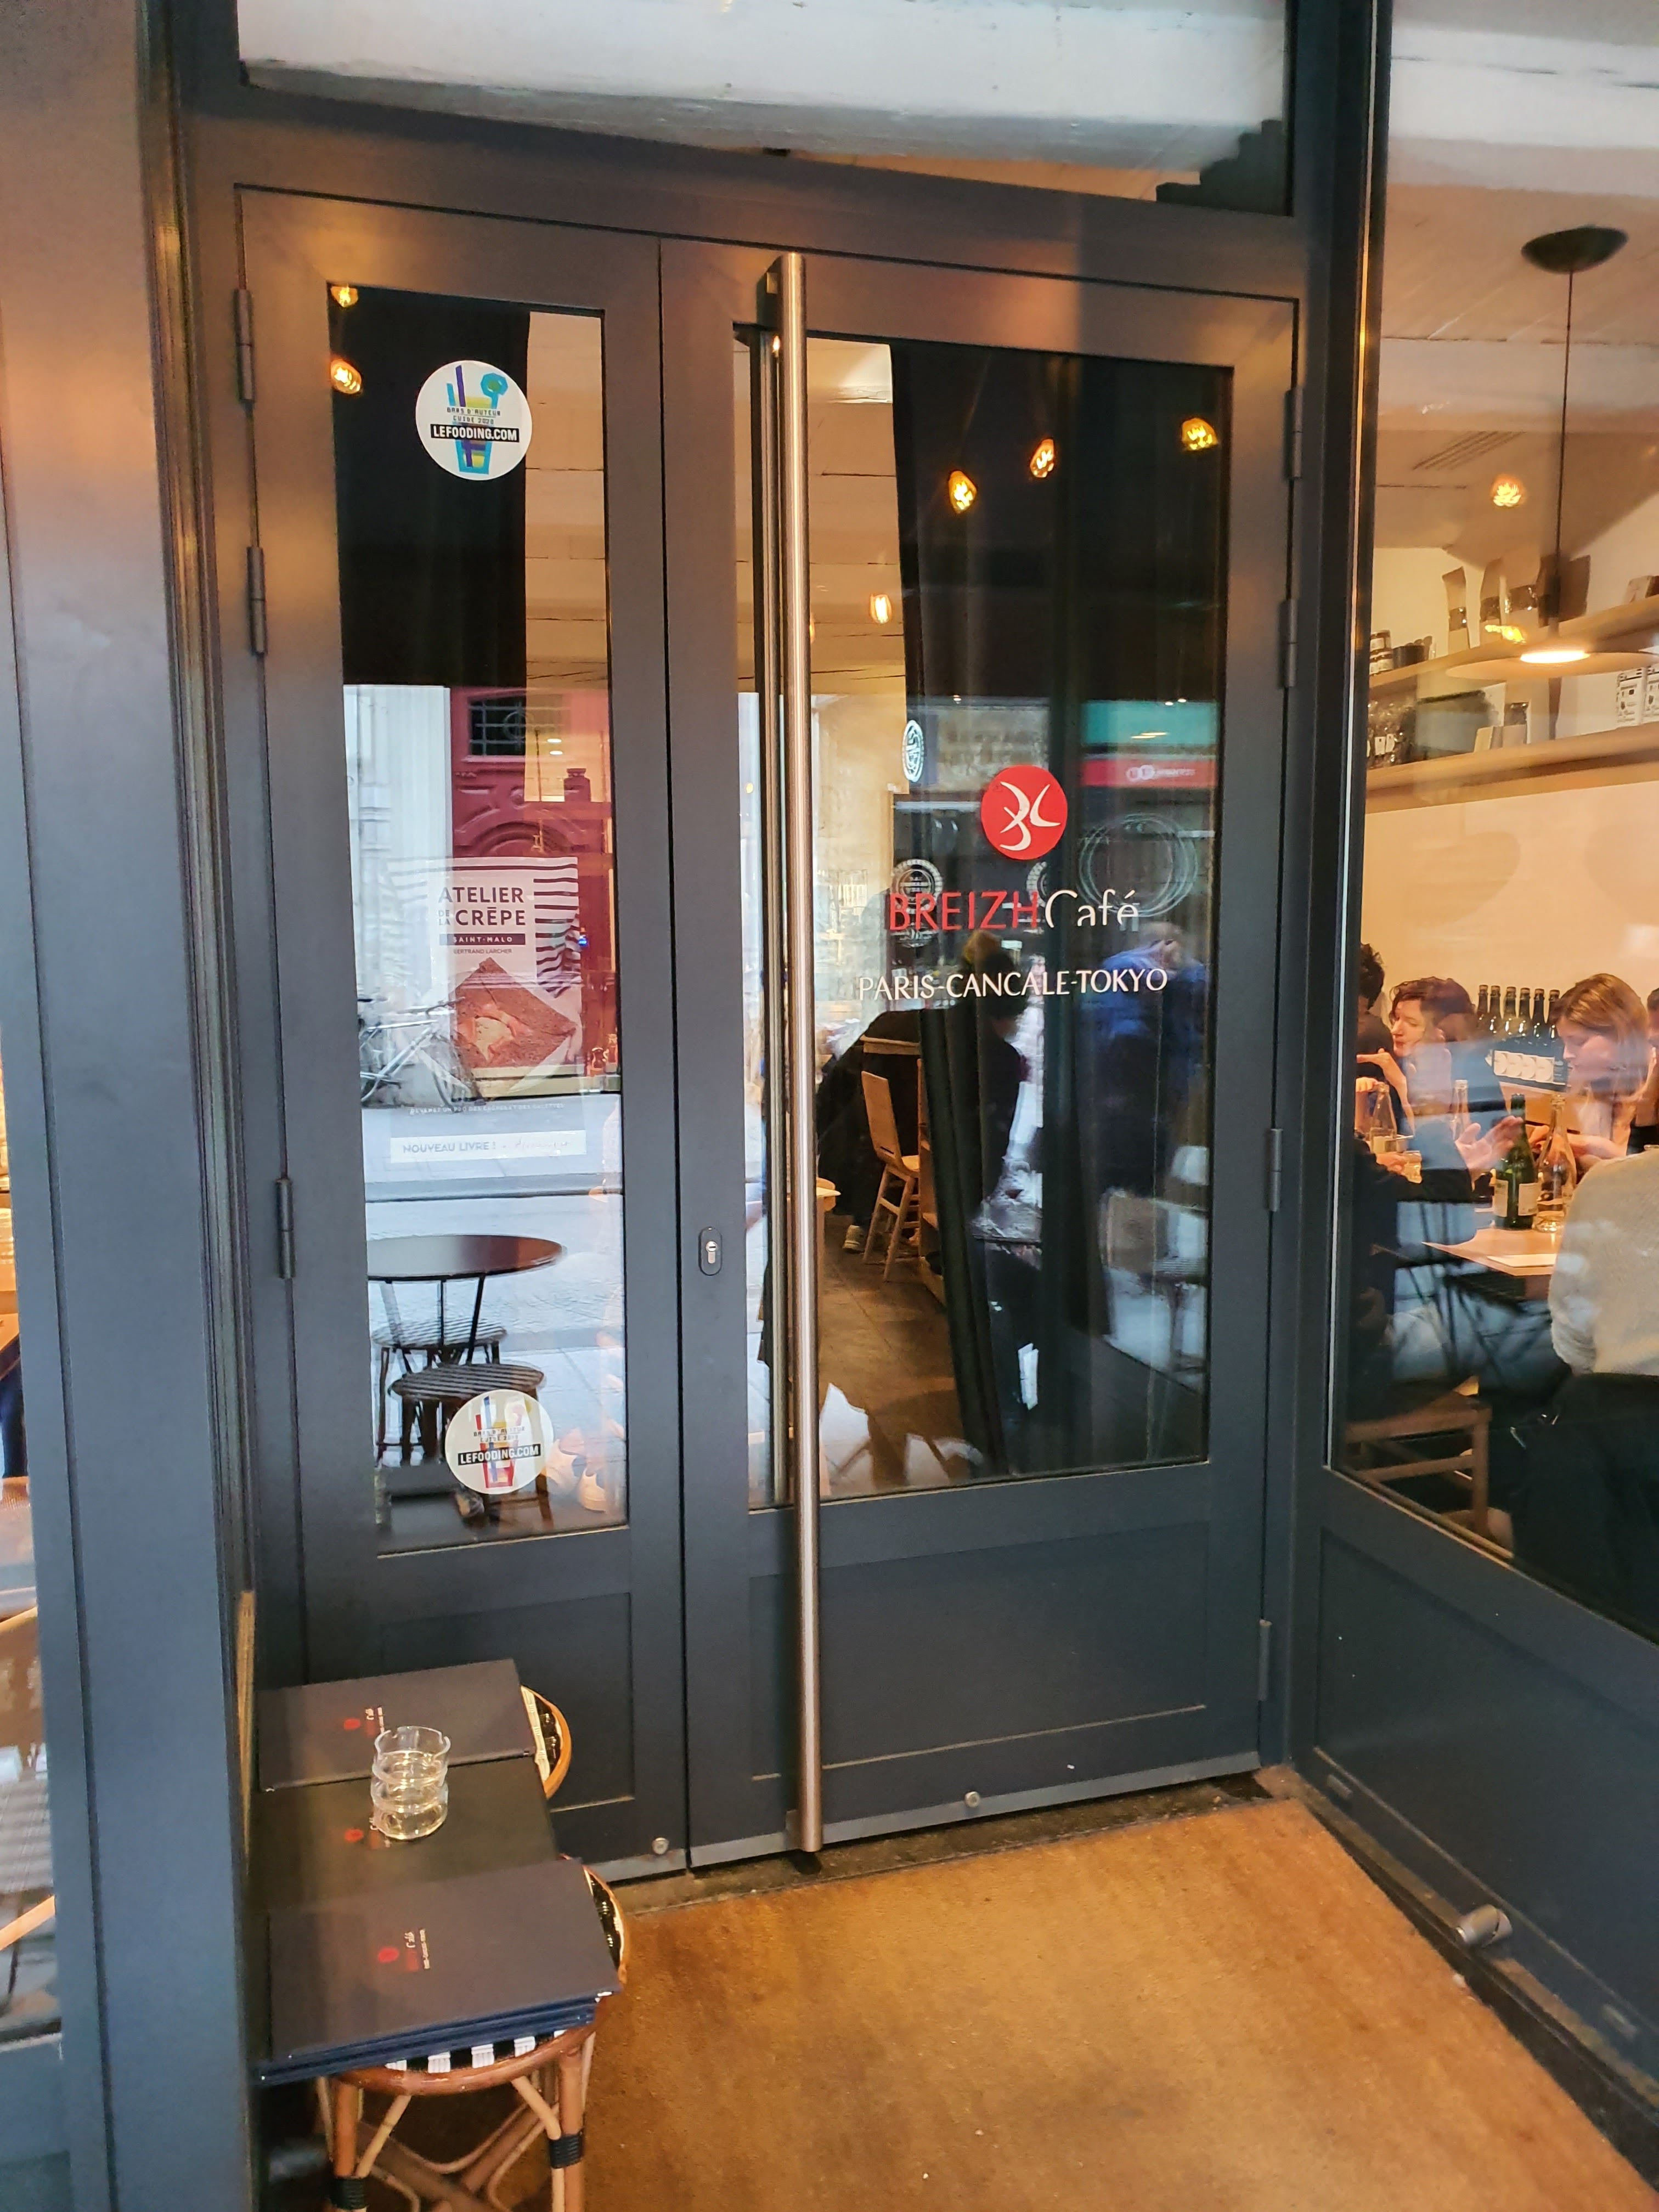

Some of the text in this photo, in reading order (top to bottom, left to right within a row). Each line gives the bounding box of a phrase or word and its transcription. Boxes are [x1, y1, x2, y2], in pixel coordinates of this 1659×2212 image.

[433, 426, 517, 441] LEFOODING.COM
[438, 887, 524, 903] ATELIER
[403, 1142, 455, 1153] NOUVEAU
[459, 1141, 489, 1152] LIVRE
[460, 1445, 539, 1464] LEFOODING.COM
